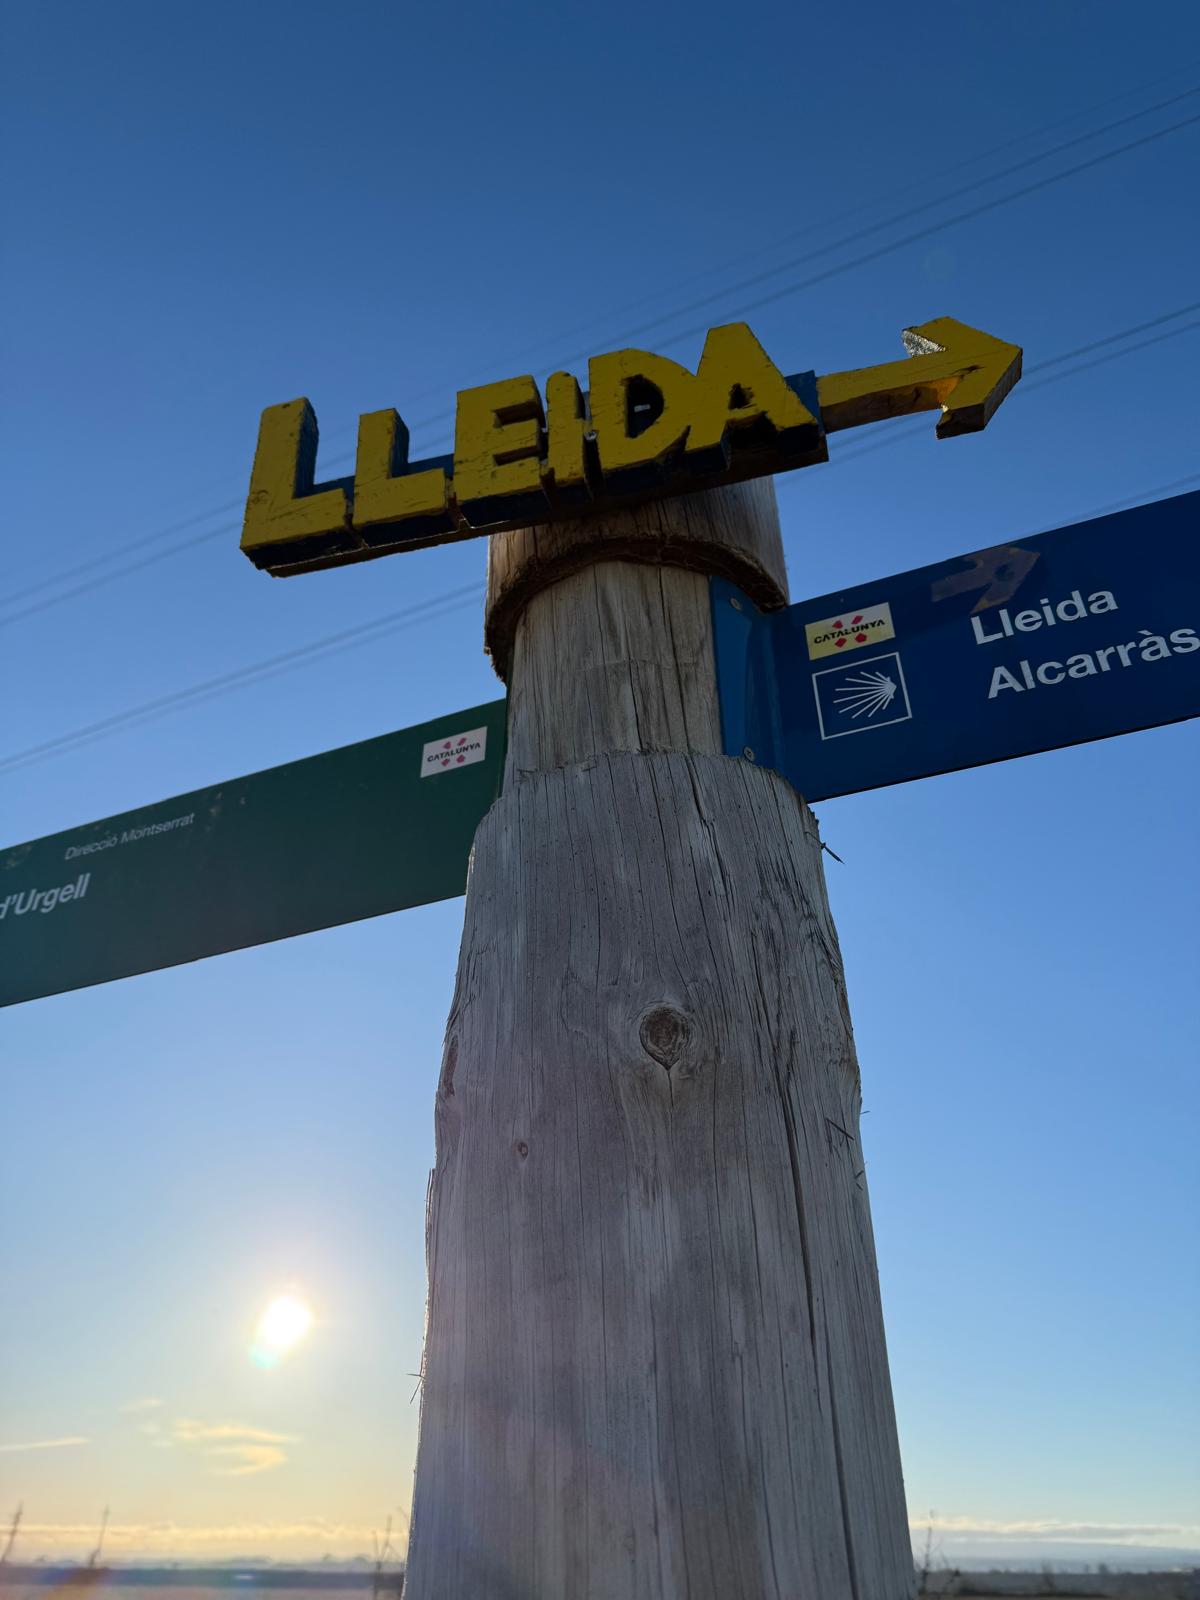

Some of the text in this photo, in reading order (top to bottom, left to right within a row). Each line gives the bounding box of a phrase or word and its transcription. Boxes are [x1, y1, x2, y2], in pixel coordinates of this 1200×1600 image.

[240, 322, 820, 560] LLEIDA
[813, 618, 885, 645] CATALUNYA
[970, 589, 1120, 646] Lleida
[987, 627, 1200, 700] Alcarràs
[426, 742, 481, 763] CATALUNYA
[64, 812, 195, 860] Direcció Montserrat
